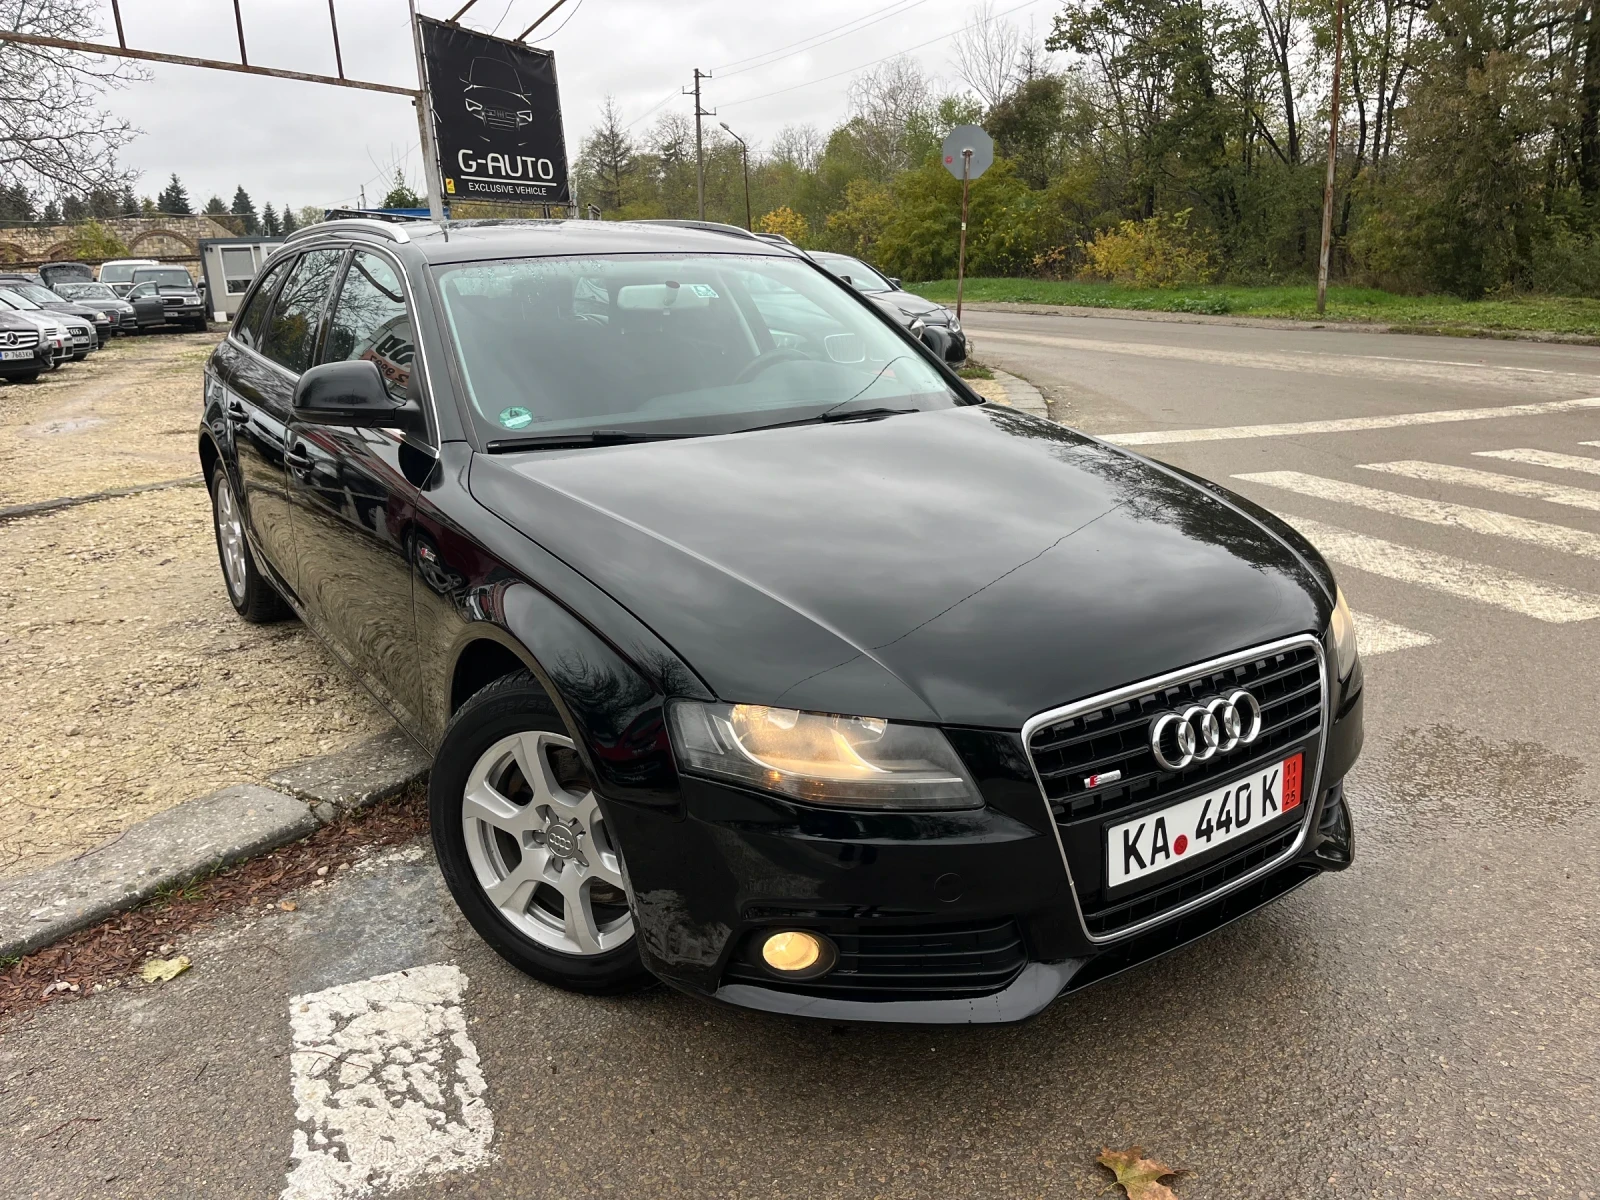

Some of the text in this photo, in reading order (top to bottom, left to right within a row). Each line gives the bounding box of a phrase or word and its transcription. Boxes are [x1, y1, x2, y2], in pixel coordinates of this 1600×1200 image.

[458, 149, 554, 179] G-AUTO
[468, 182, 547, 195] EXCLUSIVE VEHICLE
[1286, 760, 1297, 776] 11
[1286, 776, 1297, 790] 11
[1285, 790, 1296, 805] 25
[1123, 769, 1279, 875] KA 440 K
